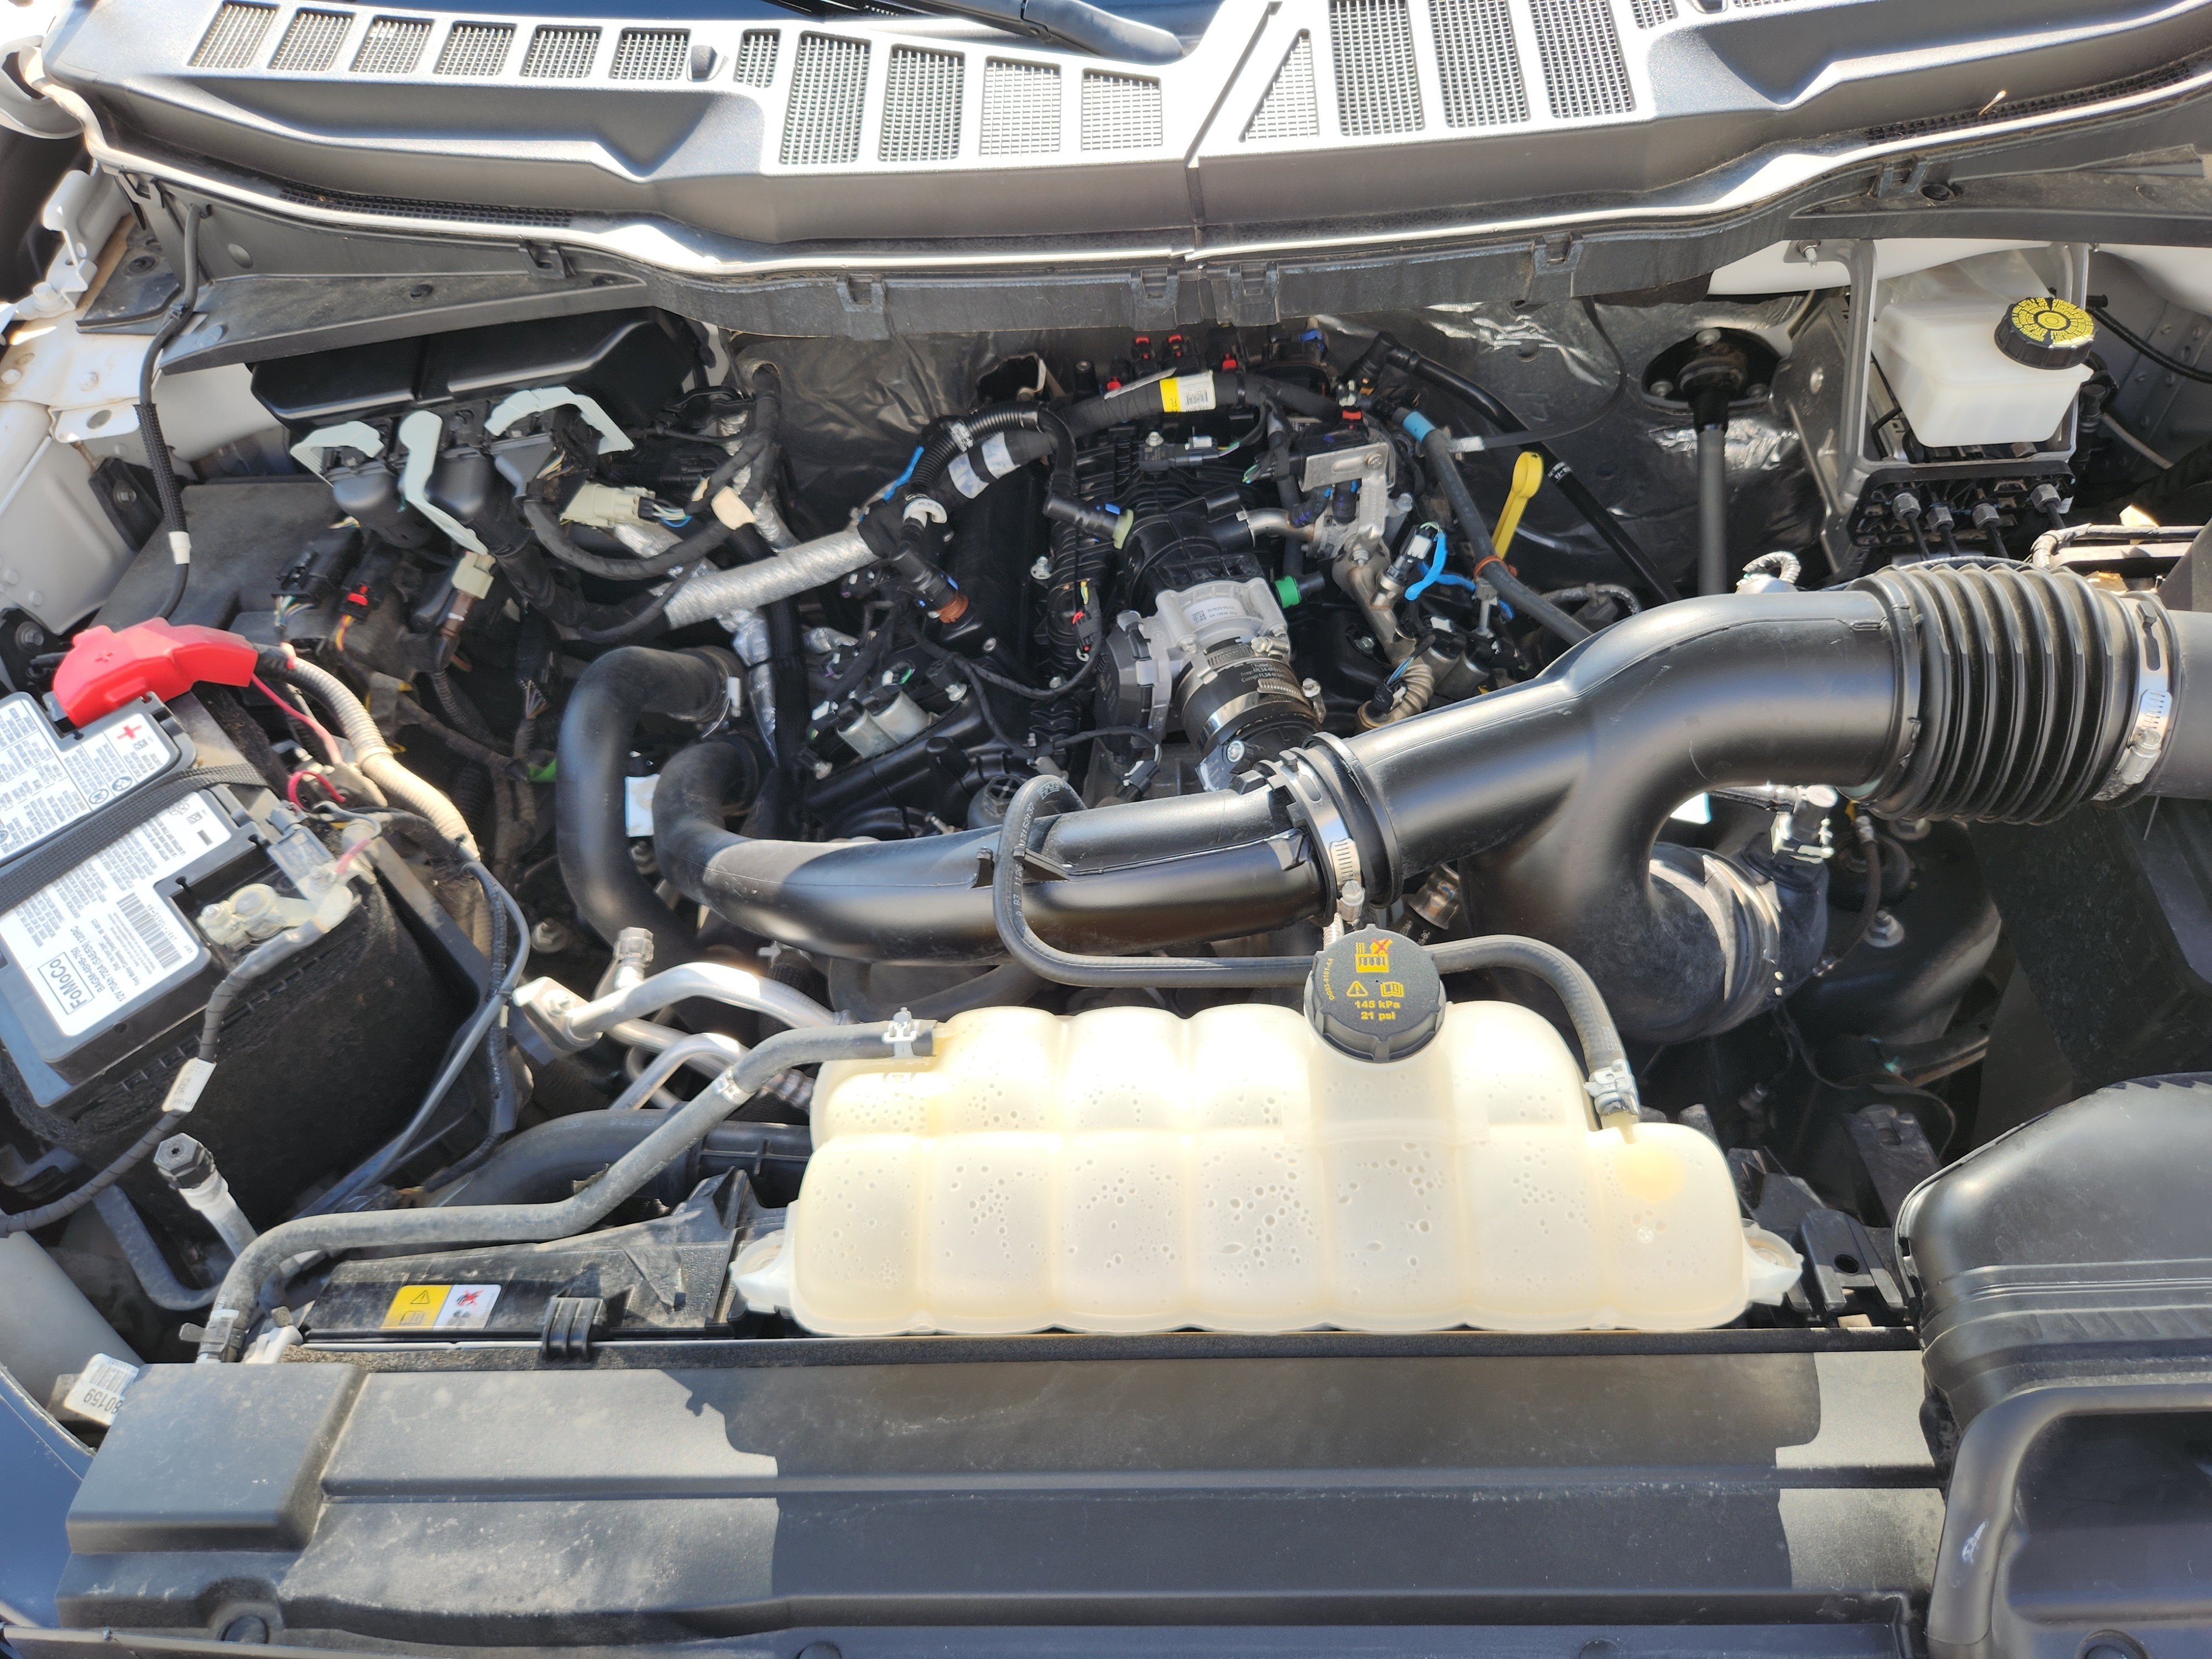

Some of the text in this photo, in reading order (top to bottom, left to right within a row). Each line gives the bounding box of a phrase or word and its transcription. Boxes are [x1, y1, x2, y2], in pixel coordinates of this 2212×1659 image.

[1012, 893, 1021, 906] B3
[70, 925, 86, 943] 120RC
[96, 963, 111, 979] 720A
[48, 957, 87, 1009] FoMoCo
[105, 976, 119, 992] 70Ah
[113, 989, 126, 1002] 12V
[1354, 1000, 1401, 1009] 145 kPa
[1360, 1011, 1396, 1021] 21 psi
[84, 1388, 123, 1414] 80159
